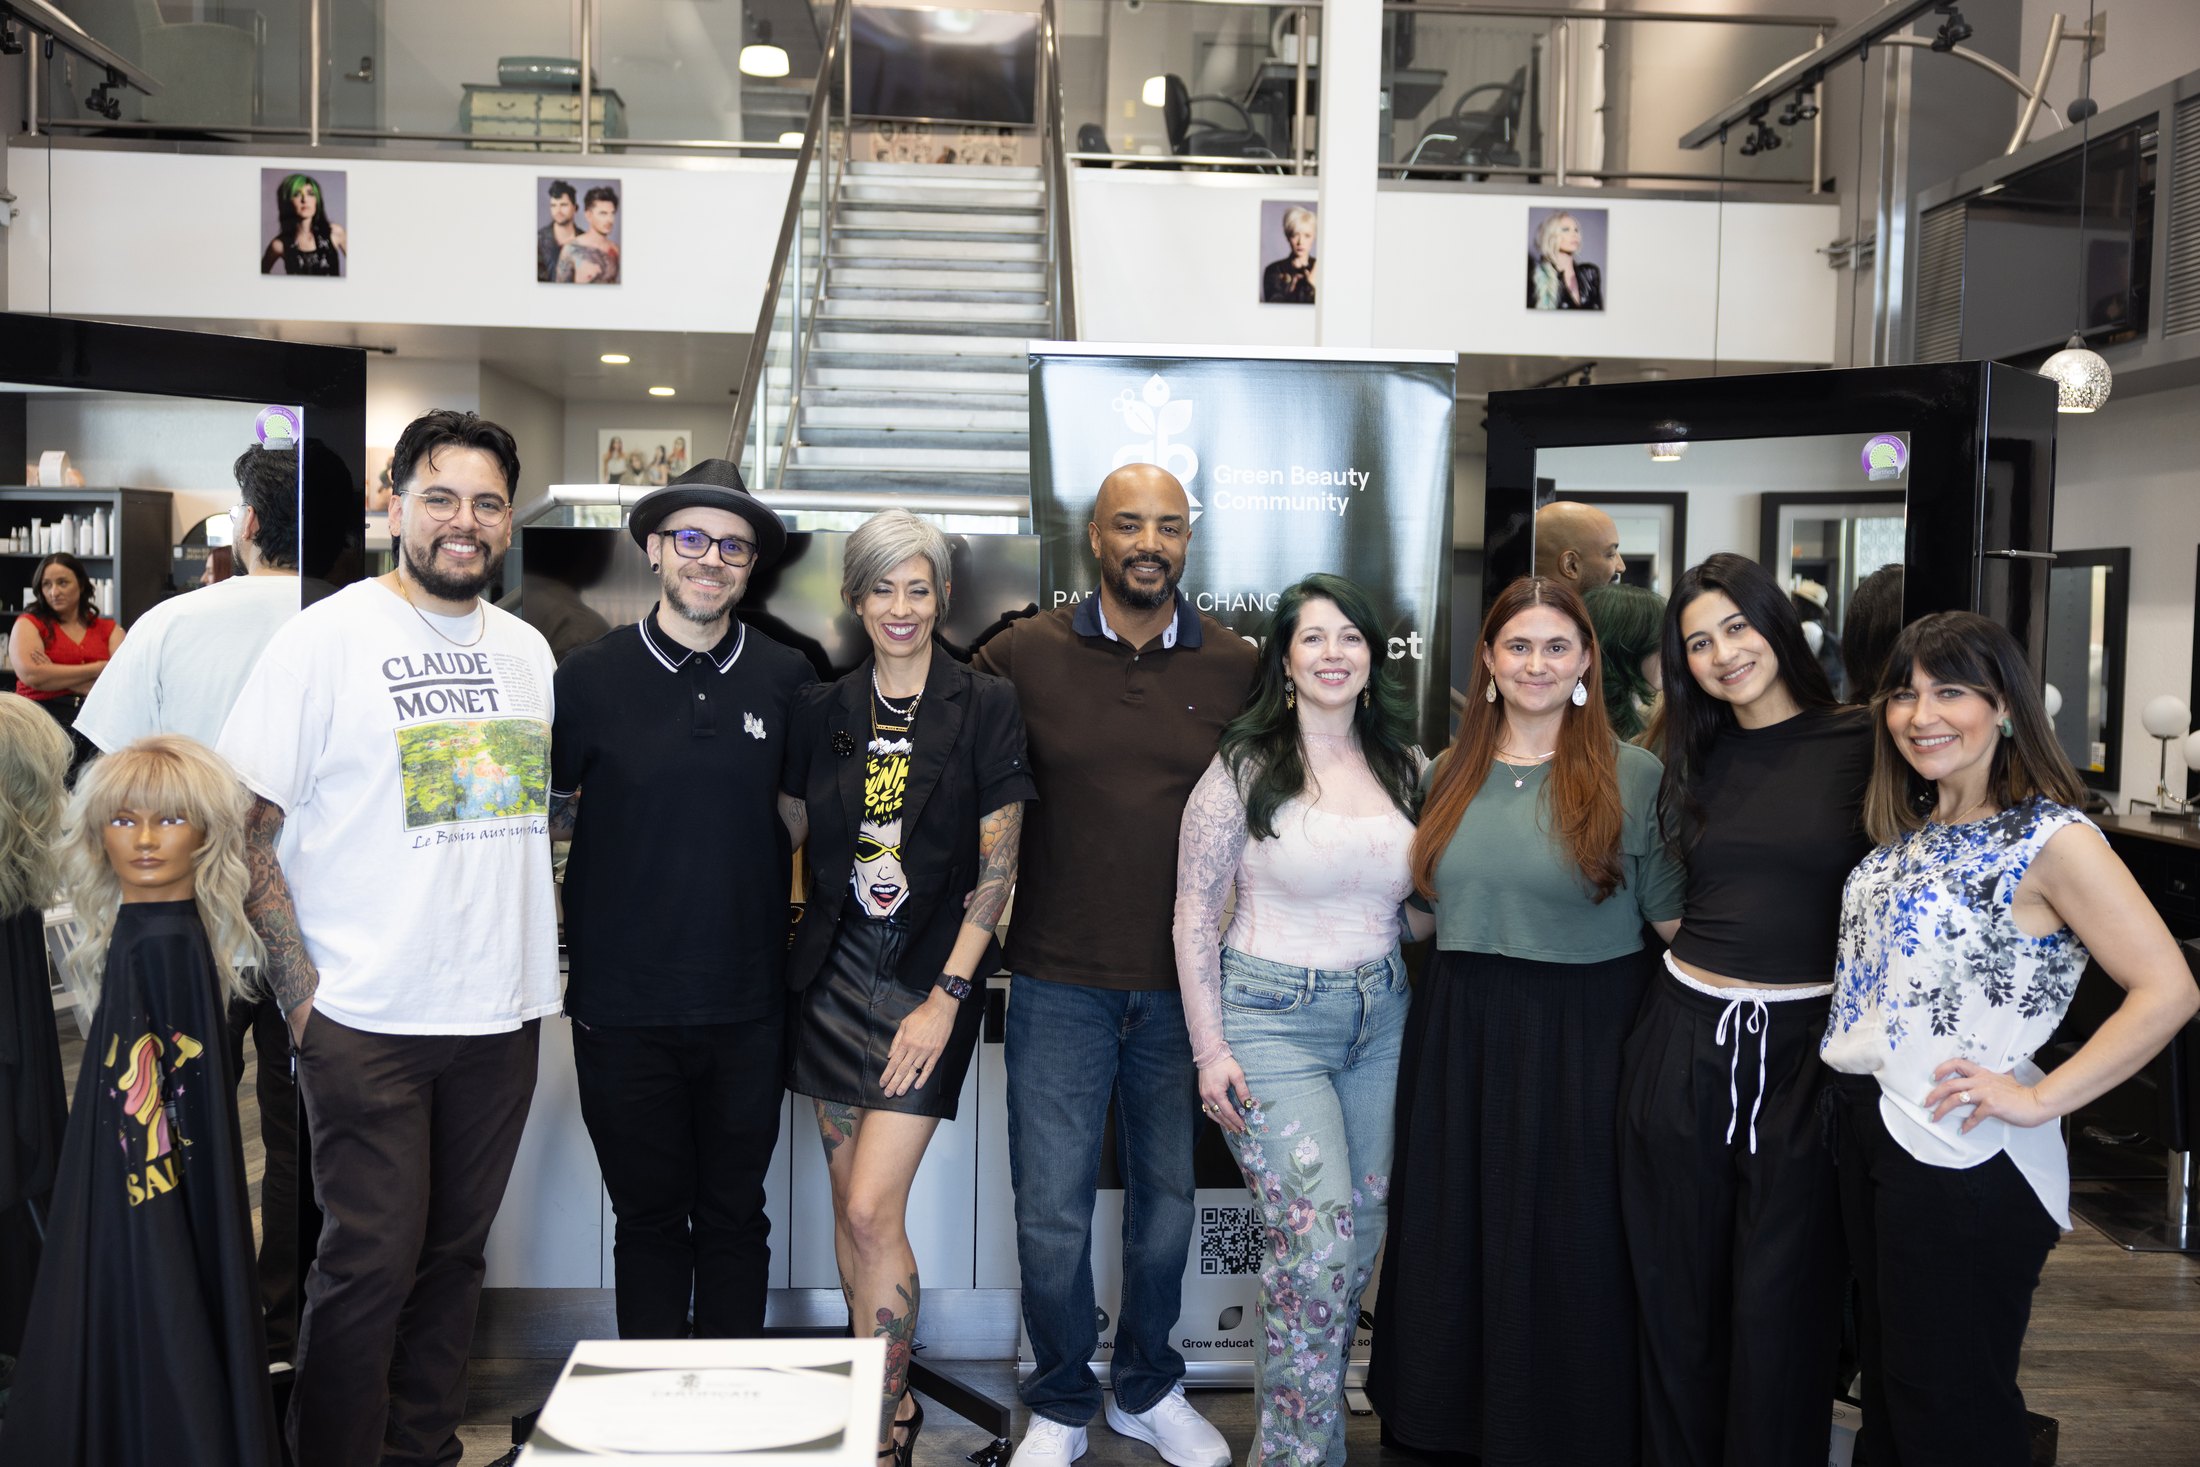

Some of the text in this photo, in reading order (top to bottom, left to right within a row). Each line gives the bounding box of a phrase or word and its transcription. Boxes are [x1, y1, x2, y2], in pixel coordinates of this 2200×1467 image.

[1213, 465, 1370, 491] Green Beauty
[1212, 490, 1349, 516] Community
[1196, 592, 1281, 612] CHANG
[381, 652, 492, 681] CLAUDE
[393, 688, 499, 721] MONET
[874, 797, 903, 816] MUS
[412, 835, 431, 849] Le
[436, 828, 477, 845] Bassin
[480, 827, 506, 840] aux
[1181, 1337, 1255, 1349] Grow educat
